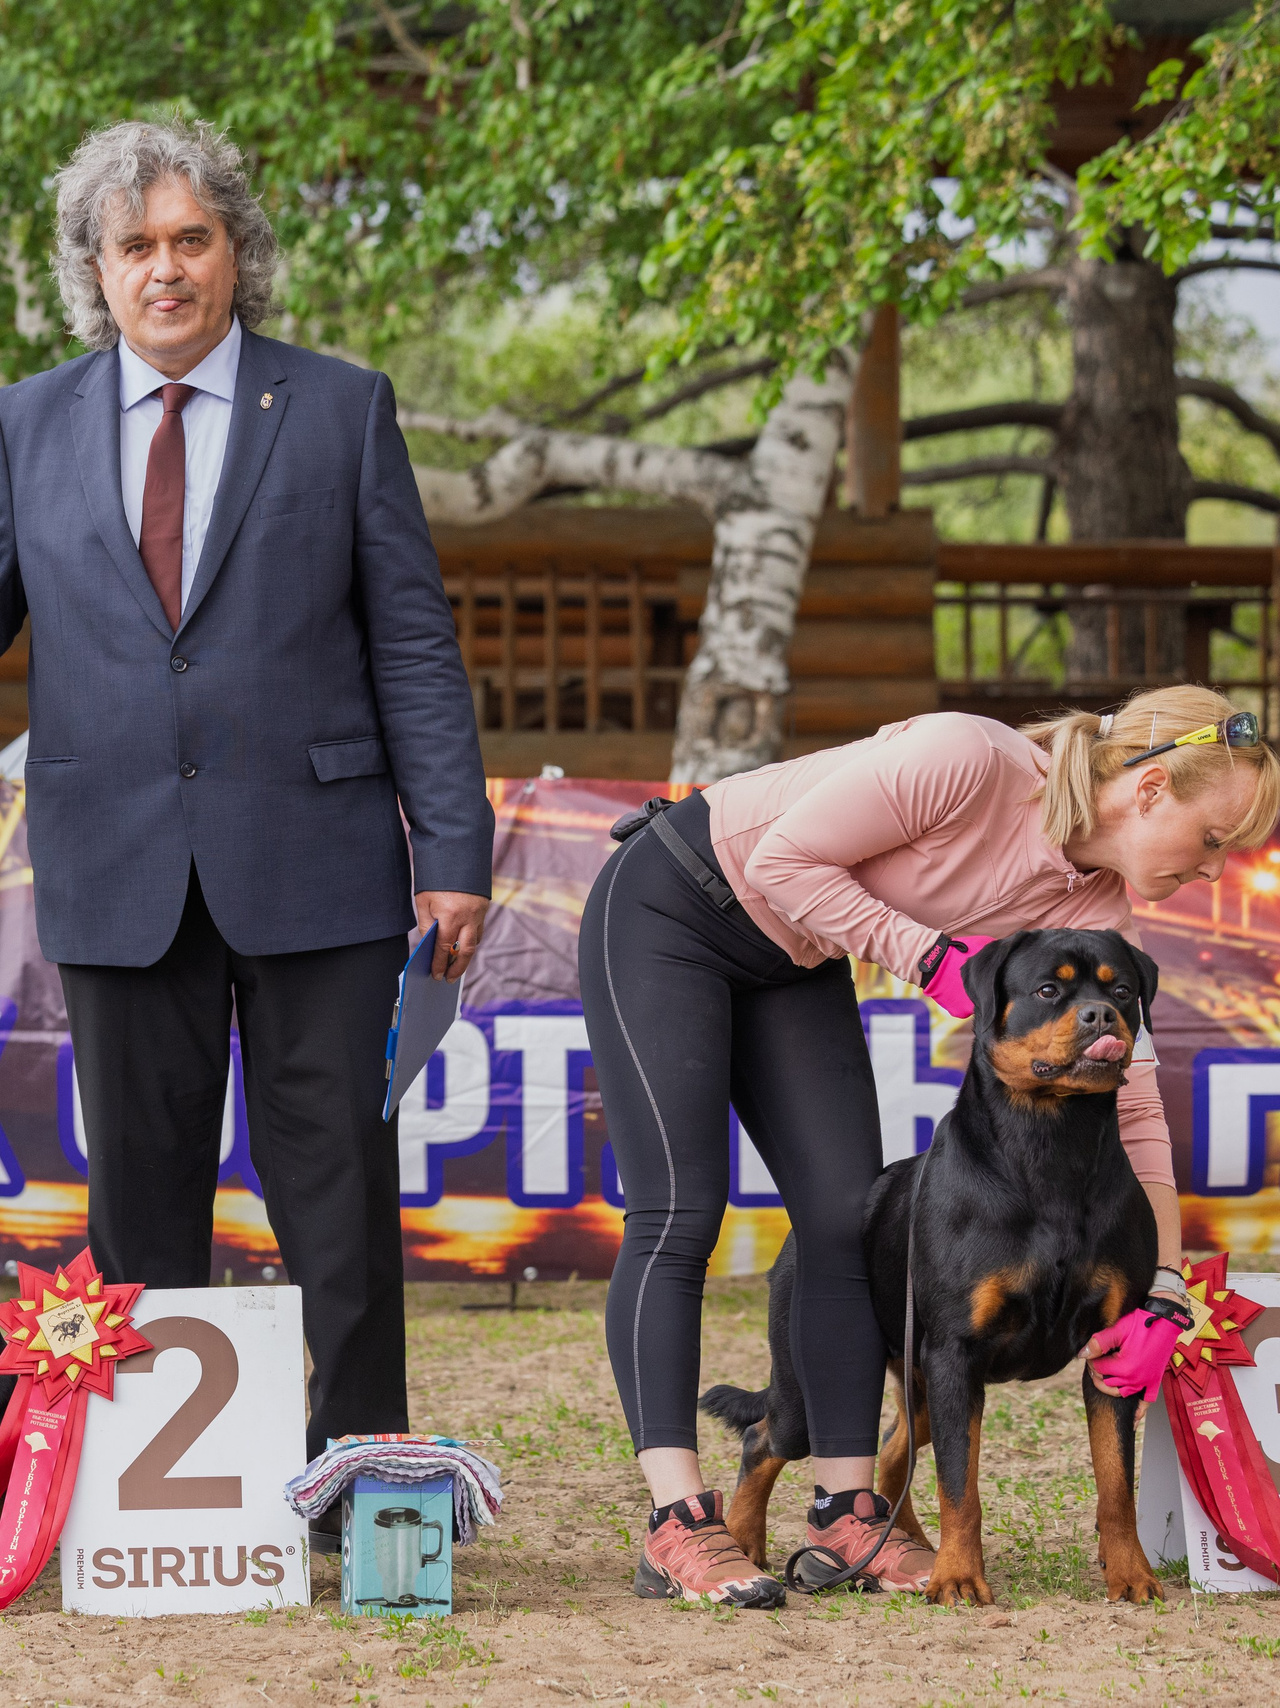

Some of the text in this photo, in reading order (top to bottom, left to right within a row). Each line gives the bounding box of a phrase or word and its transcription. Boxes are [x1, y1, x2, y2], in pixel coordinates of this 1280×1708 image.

[30, 1420, 58, 1430] РОТВЕЙЛЕР
[32, 1414, 58, 1424] ВЫСТАВКА
[115, 1316, 243, 1511] 2
[24, 1458, 37, 1495] КУБОК
[1213, 1445, 1229, 1481] КУБОК
[1225, 1484, 1247, 1531] ФОРТУНЫ
[9, 1499, 29, 1551] ФОРТУНЫ
[76, 1548, 85, 1590] PREMIUM
[1200, 1531, 1211, 1572] PREMIUM
